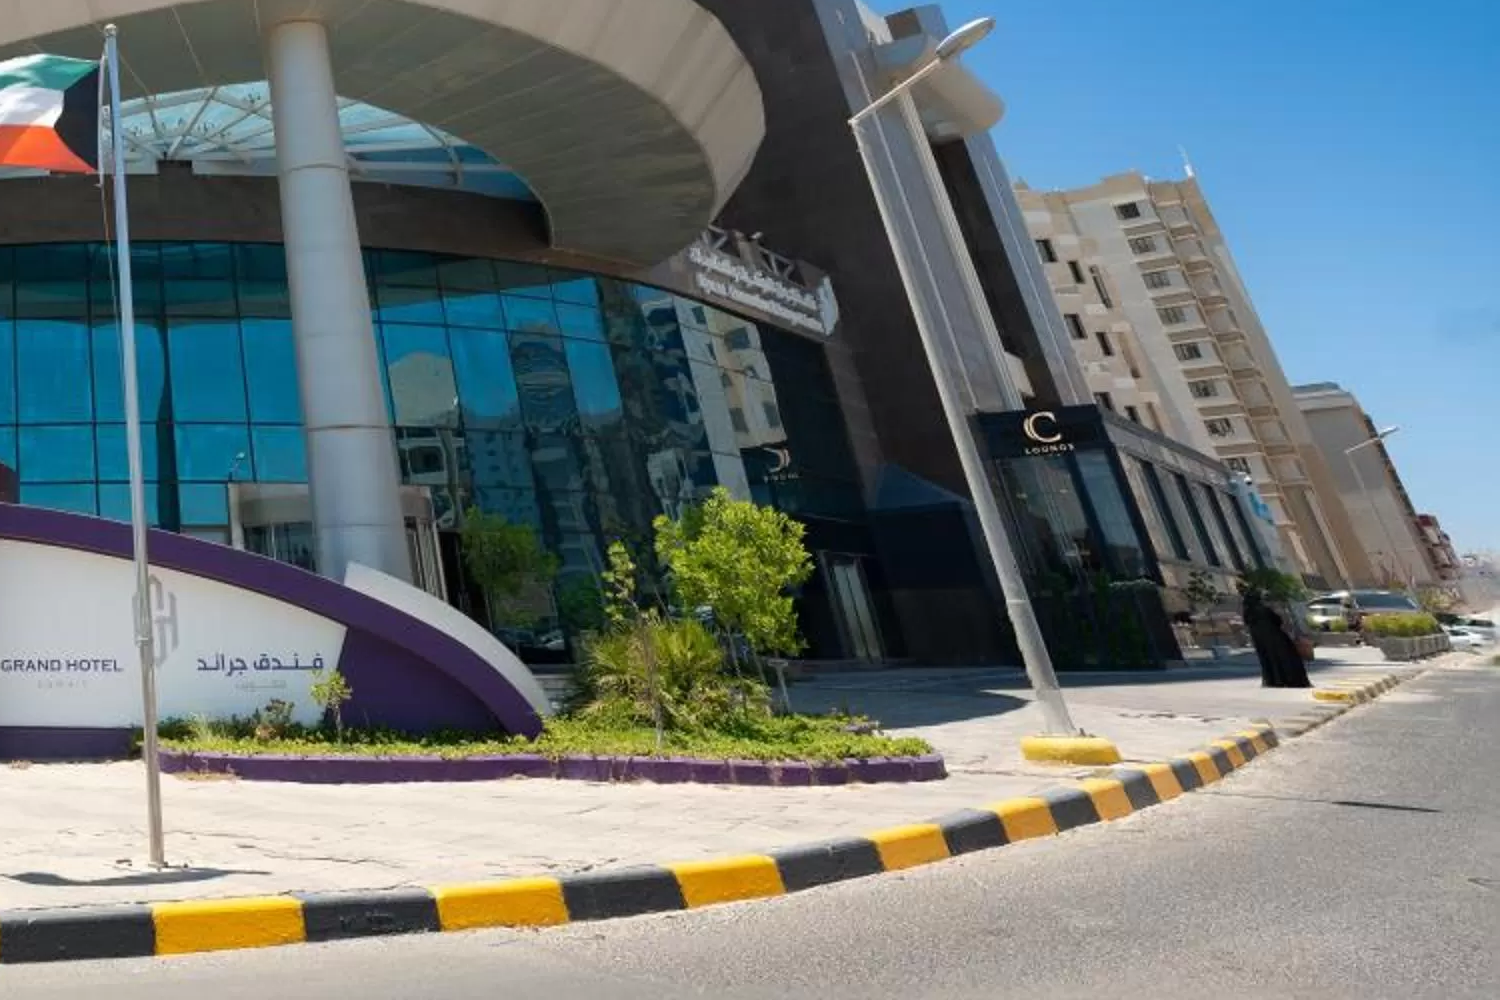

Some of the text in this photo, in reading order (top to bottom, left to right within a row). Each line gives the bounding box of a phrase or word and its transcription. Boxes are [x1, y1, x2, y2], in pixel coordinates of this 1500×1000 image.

[0, 658, 124, 673] GRAND HOTEL
[196, 652, 325, 677] فندق جراند
